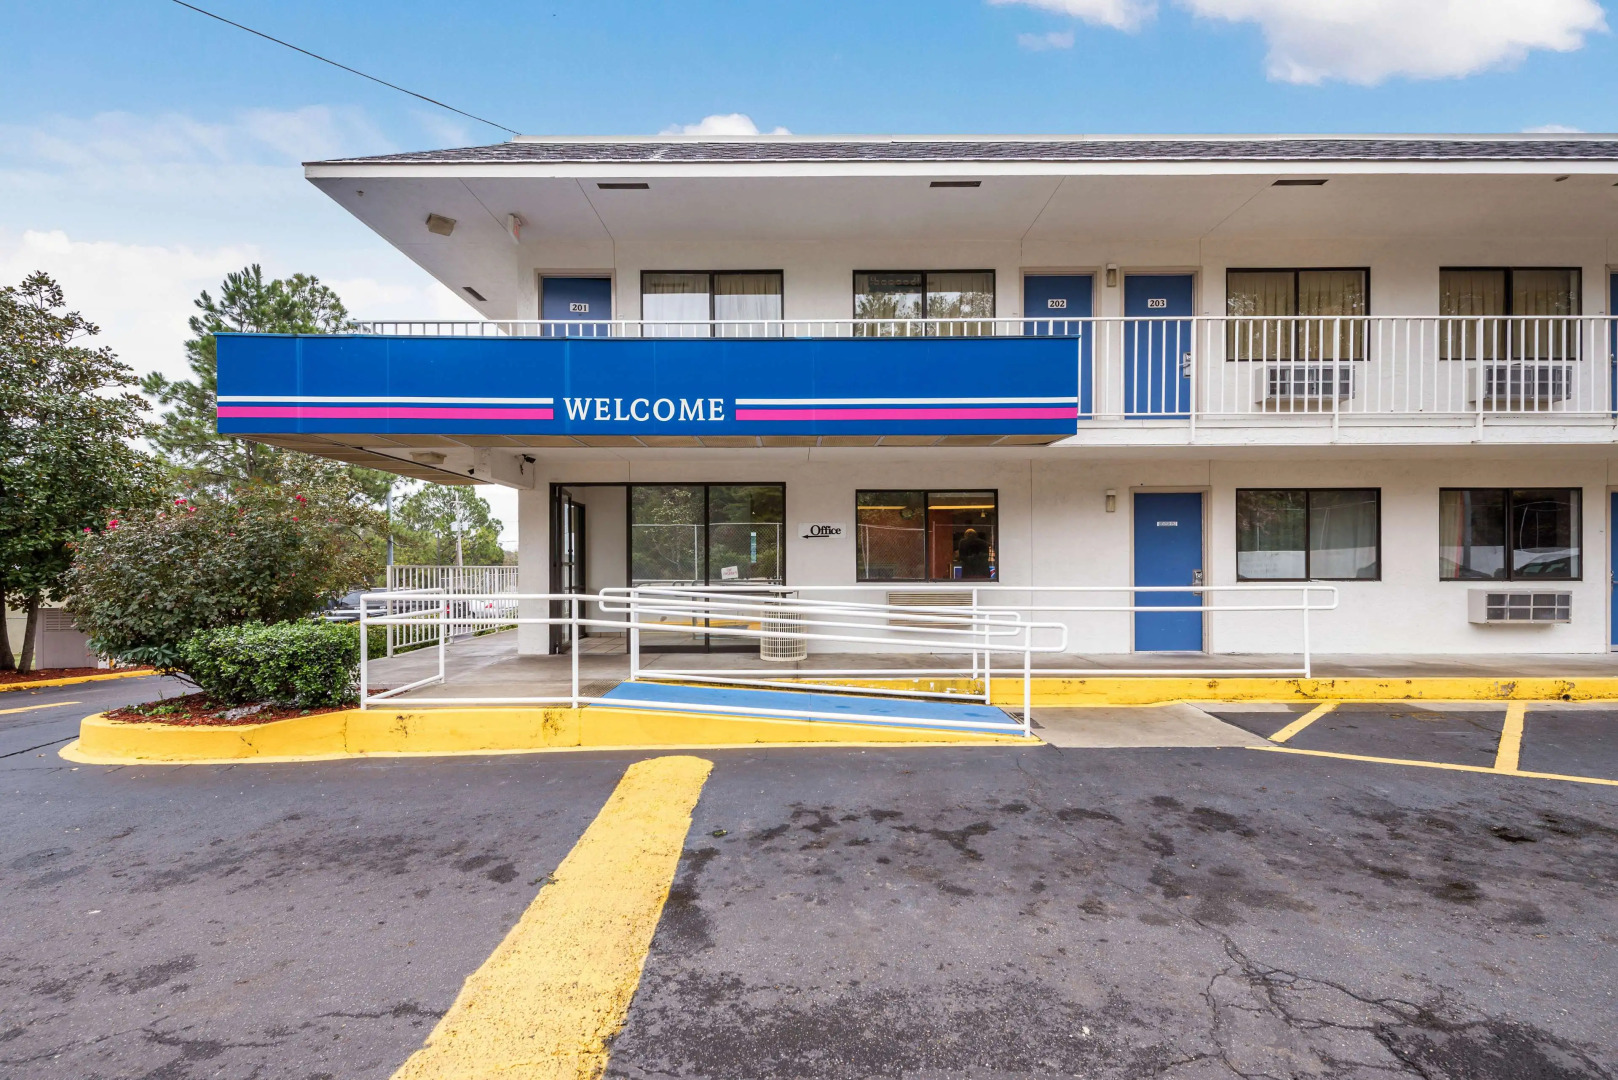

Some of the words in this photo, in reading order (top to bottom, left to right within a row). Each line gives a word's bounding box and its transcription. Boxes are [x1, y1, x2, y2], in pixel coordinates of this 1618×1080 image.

[572, 303, 588, 312] 201
[1049, 300, 1065, 308] 202
[1149, 299, 1165, 307] 203
[563, 397, 725, 422] WELCOME
[810, 524, 842, 536] Office
